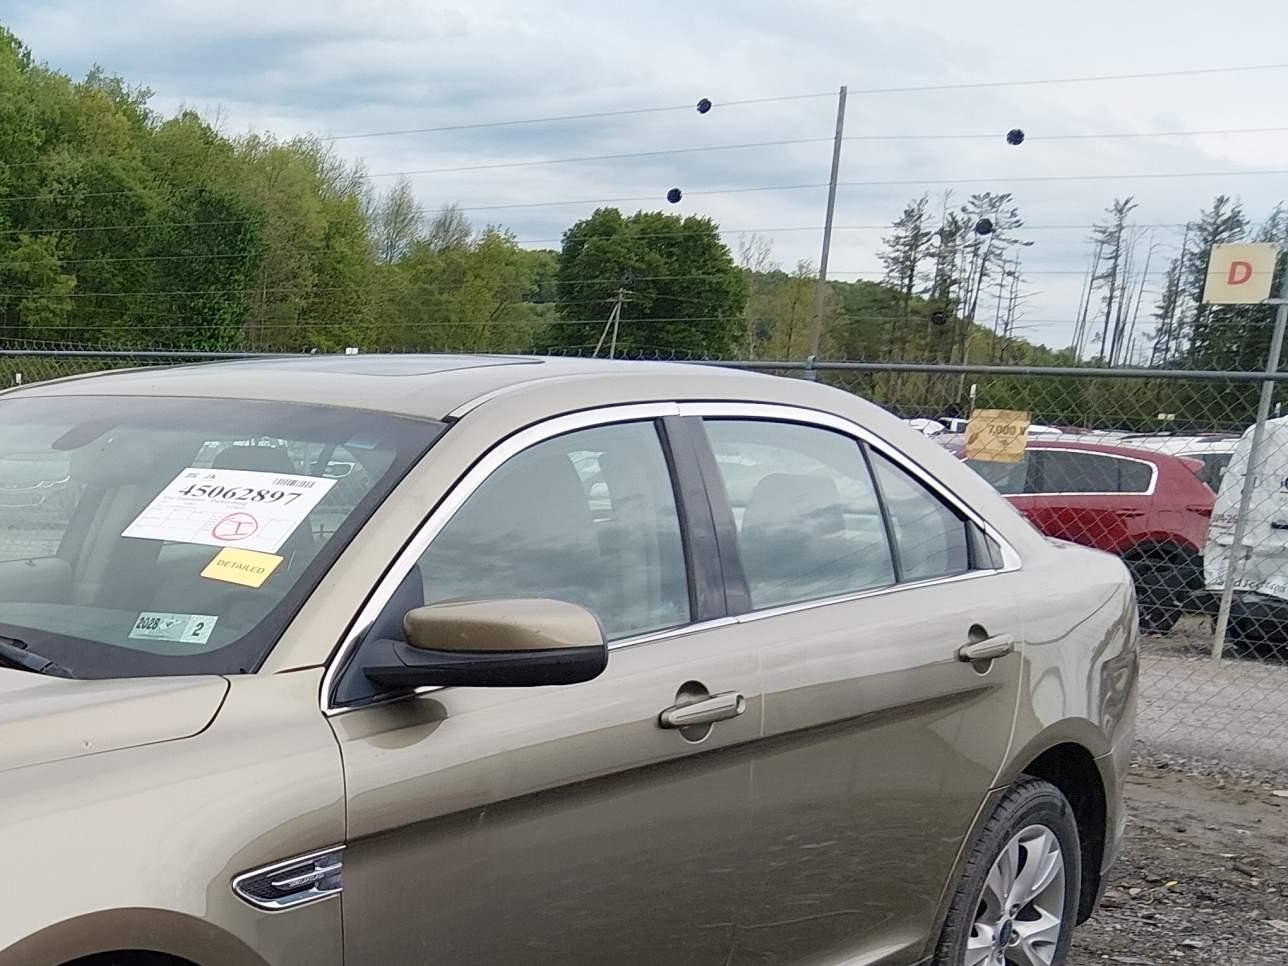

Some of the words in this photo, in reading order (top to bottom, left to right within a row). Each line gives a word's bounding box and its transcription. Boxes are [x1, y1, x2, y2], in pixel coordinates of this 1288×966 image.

[1227, 261, 1253, 285] D
[178, 483, 303, 506] 45062897
[216, 558, 266, 575] DETAILED
[191, 621, 205, 637] 2
